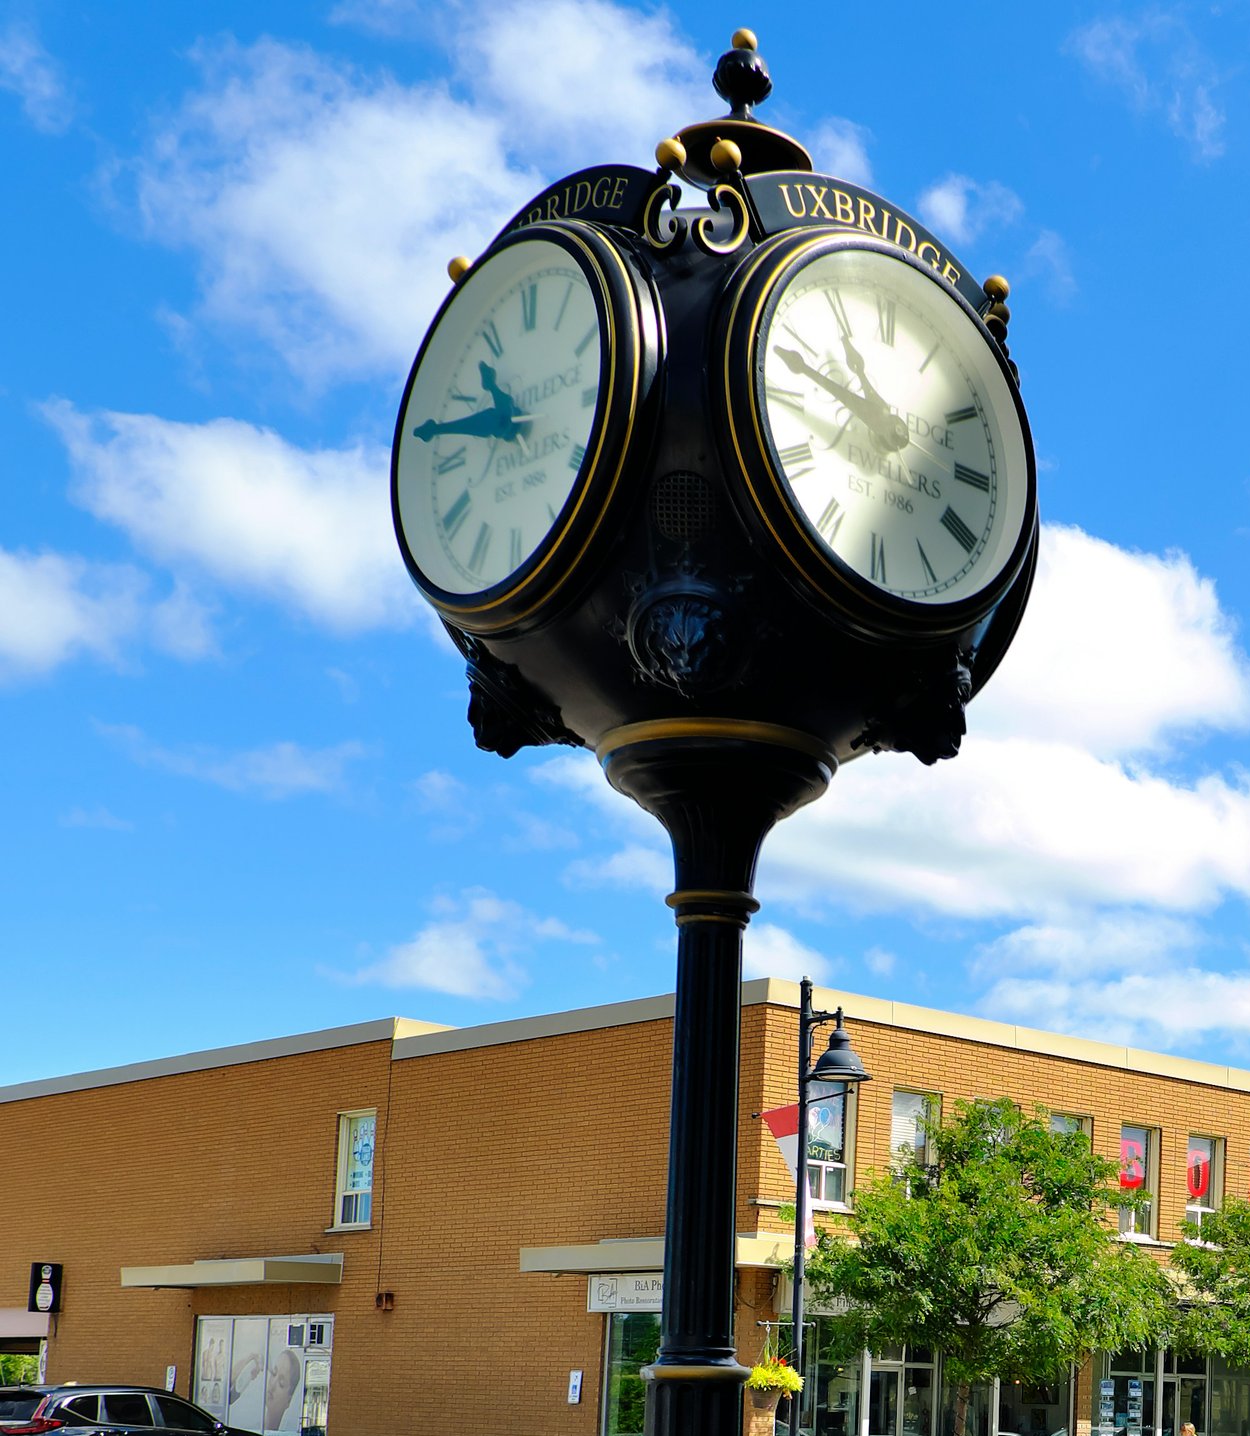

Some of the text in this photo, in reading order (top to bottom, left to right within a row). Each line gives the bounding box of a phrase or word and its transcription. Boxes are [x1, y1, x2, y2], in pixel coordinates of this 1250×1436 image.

[520, 177, 628, 226] BRIDGE
[778, 184, 961, 287] UXBRIDGE
[884, 490, 914, 514] 1986
[807, 1145, 841, 1162] ARTIES
[651, 1280, 663, 1291] Ph
